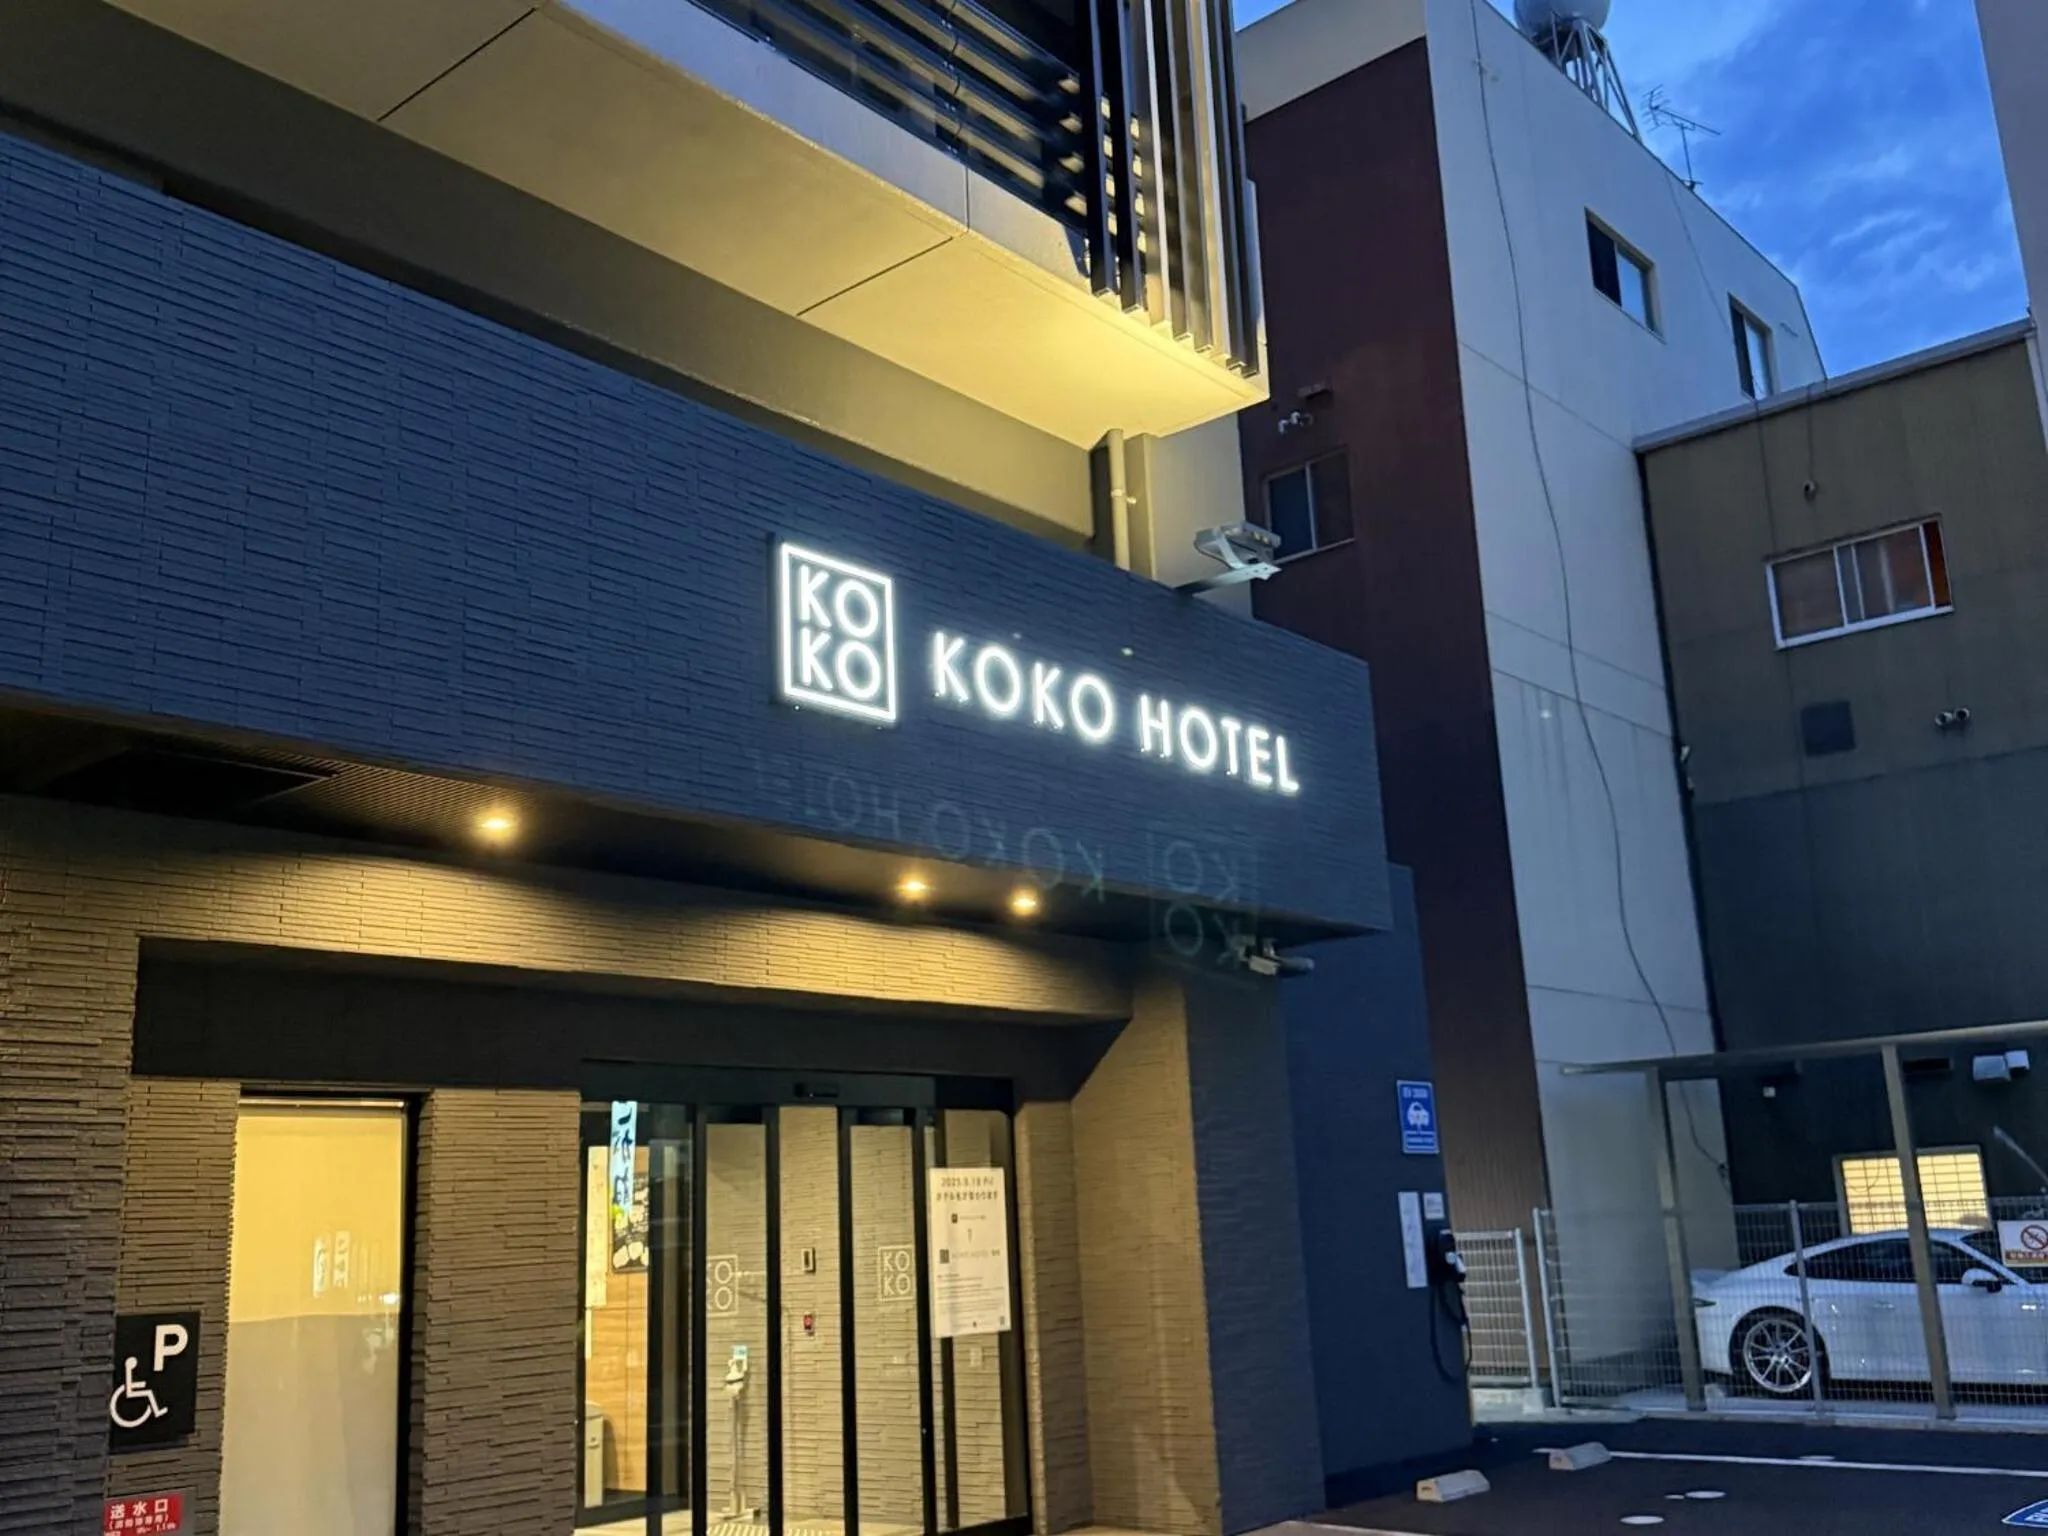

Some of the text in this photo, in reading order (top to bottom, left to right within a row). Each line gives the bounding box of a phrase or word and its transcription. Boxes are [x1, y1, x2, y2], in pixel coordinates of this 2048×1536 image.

[797, 562, 881, 641] KO
[797, 624, 883, 702] KO
[931, 631, 1299, 793] KOKO HOTEL
[883, 1250, 910, 1273] KO
[883, 1273, 911, 1297] KO
[154, 1324, 188, 1372] P
[110, 1499, 169, 1520] 送水口
